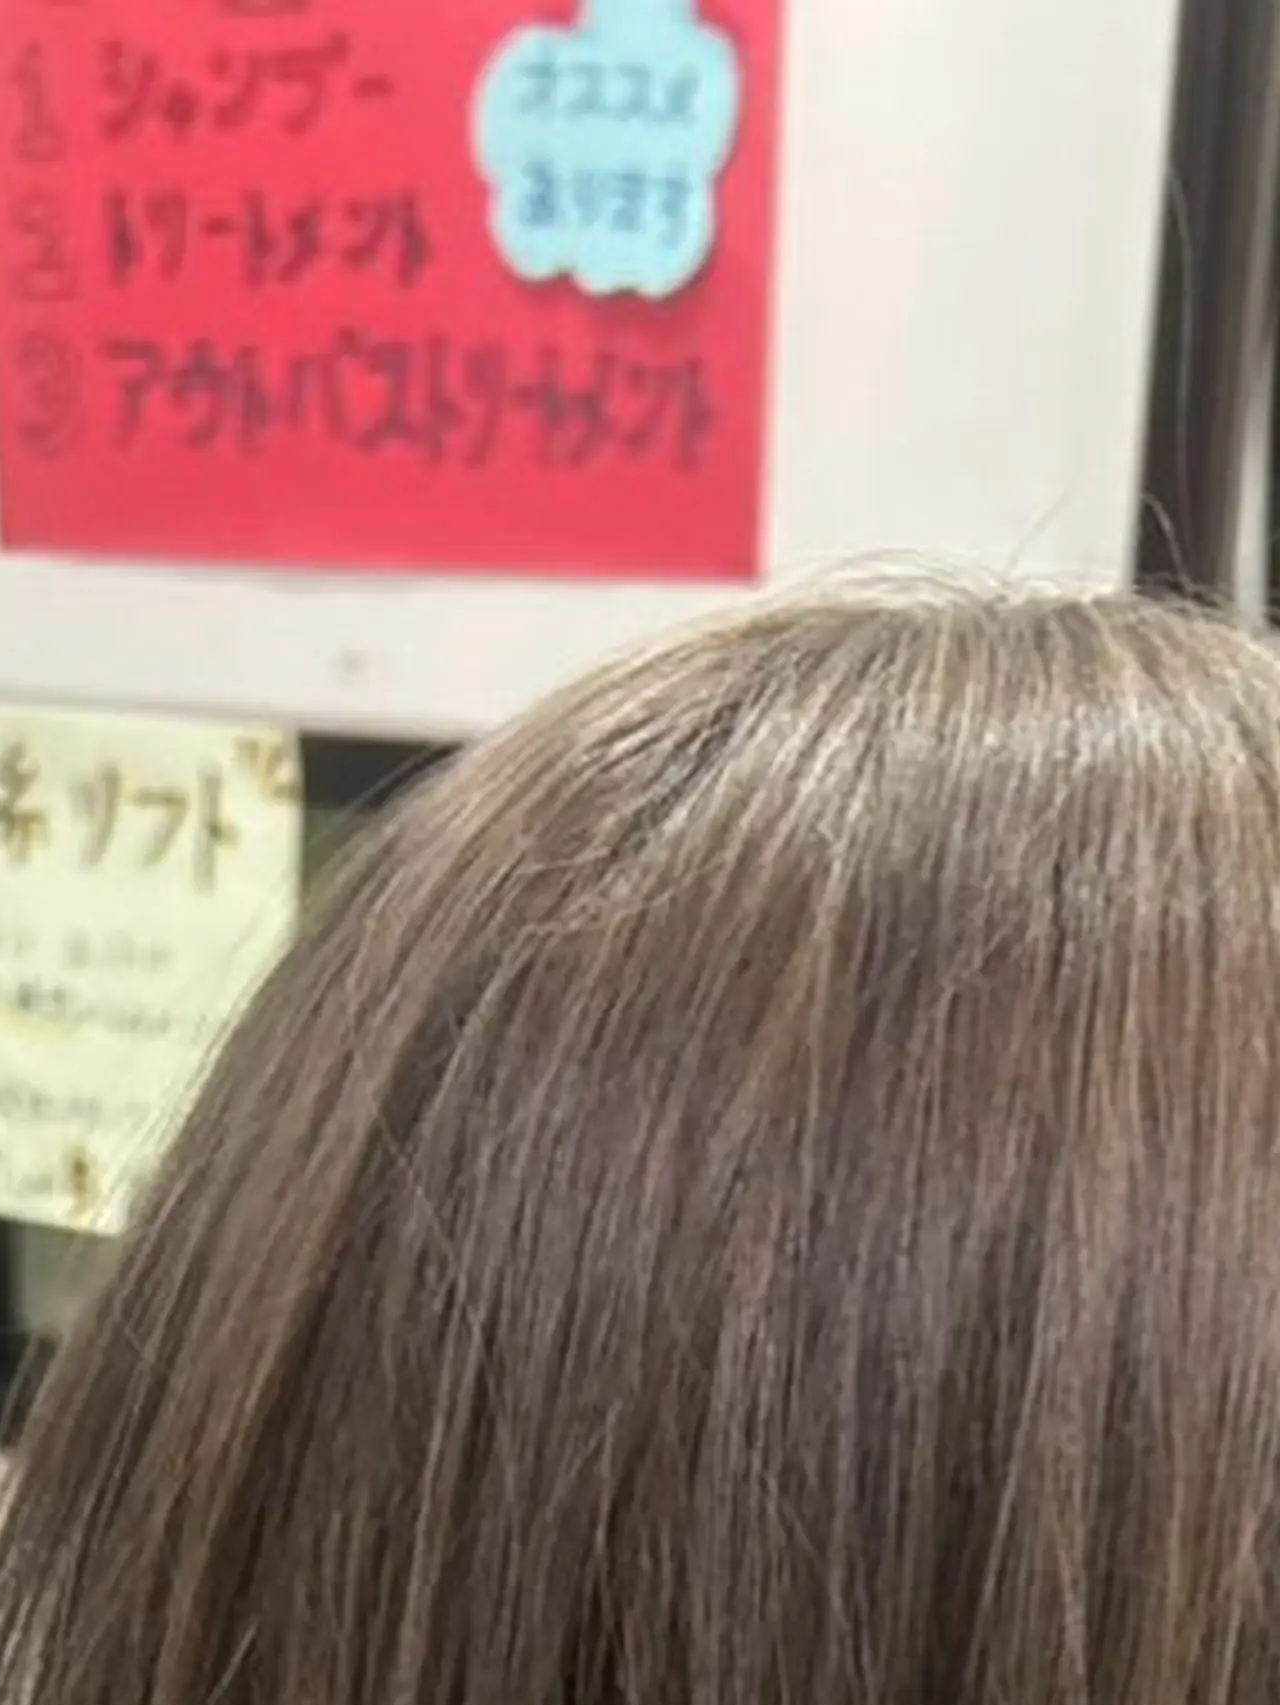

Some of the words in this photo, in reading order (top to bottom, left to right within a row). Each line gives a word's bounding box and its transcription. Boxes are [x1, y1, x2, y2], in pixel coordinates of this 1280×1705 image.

[102, 187, 435, 290] トリートメント
